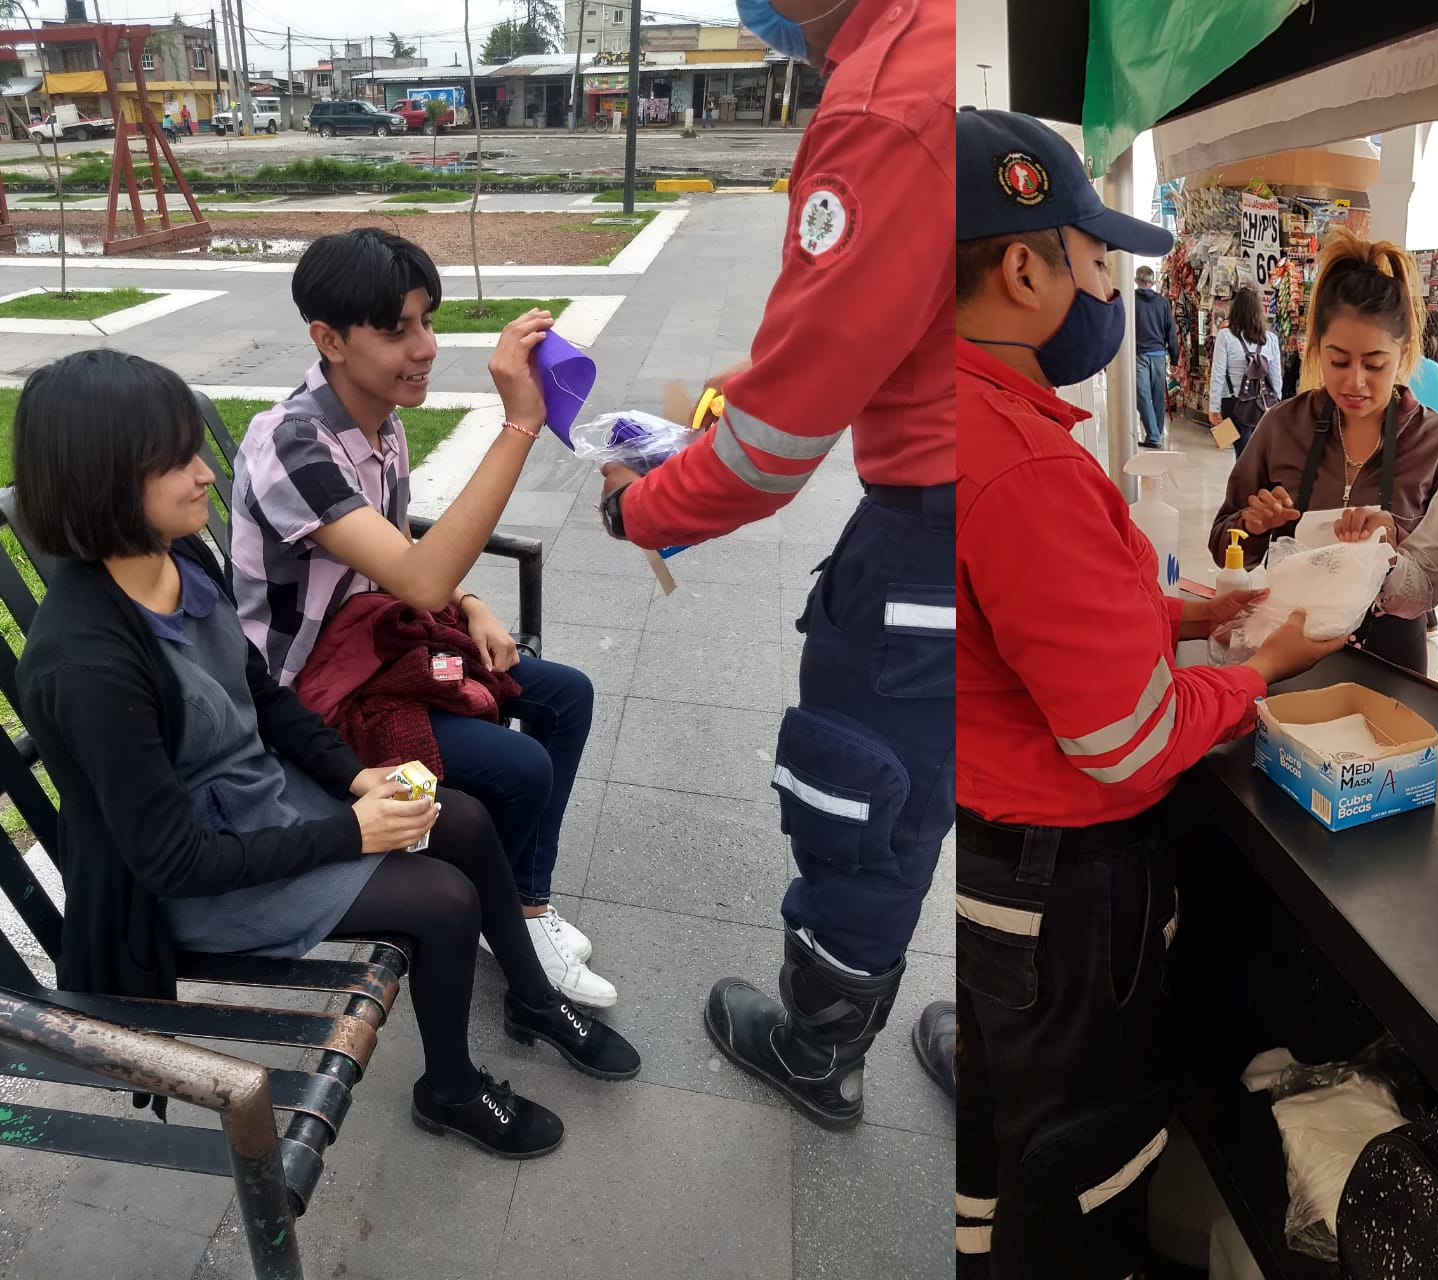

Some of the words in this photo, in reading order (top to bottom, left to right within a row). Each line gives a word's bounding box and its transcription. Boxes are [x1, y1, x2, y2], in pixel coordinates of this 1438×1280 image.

[1242, 211, 1279, 244] CHIP'S
[1278, 747, 1302, 769] Cubre
[1280, 757, 1302, 779] Bocas
[1341, 762, 1375, 779] MEDI
[1340, 776, 1372, 791] MASK
[1376, 769, 1397, 803] A
[1338, 793, 1373, 809] Cubre
[1337, 803, 1372, 820] Bocas
